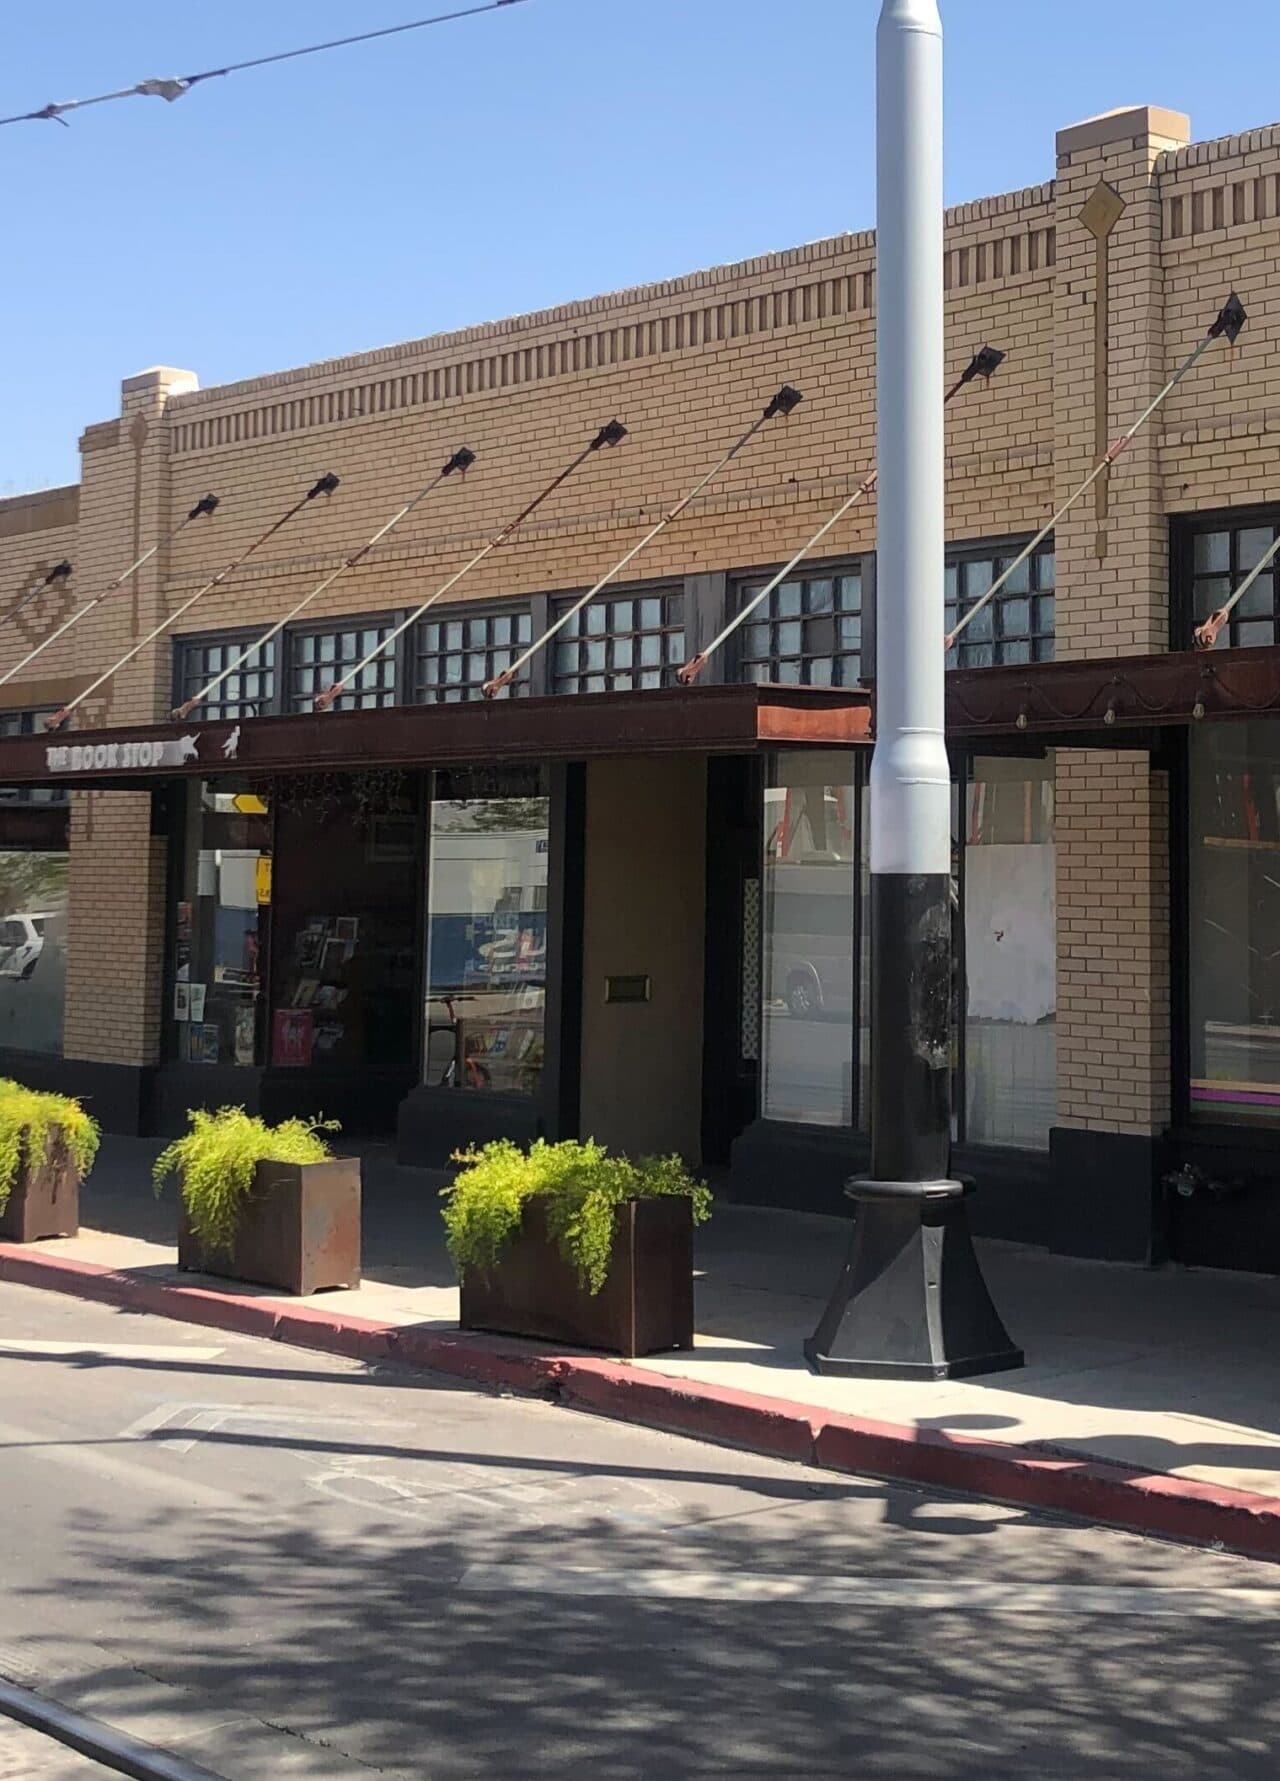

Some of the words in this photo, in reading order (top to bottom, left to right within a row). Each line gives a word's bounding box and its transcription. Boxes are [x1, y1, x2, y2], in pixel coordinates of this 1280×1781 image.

[46, 746, 70, 769] THE
[71, 744, 119, 770] BOOK
[122, 742, 164, 768] STOP
